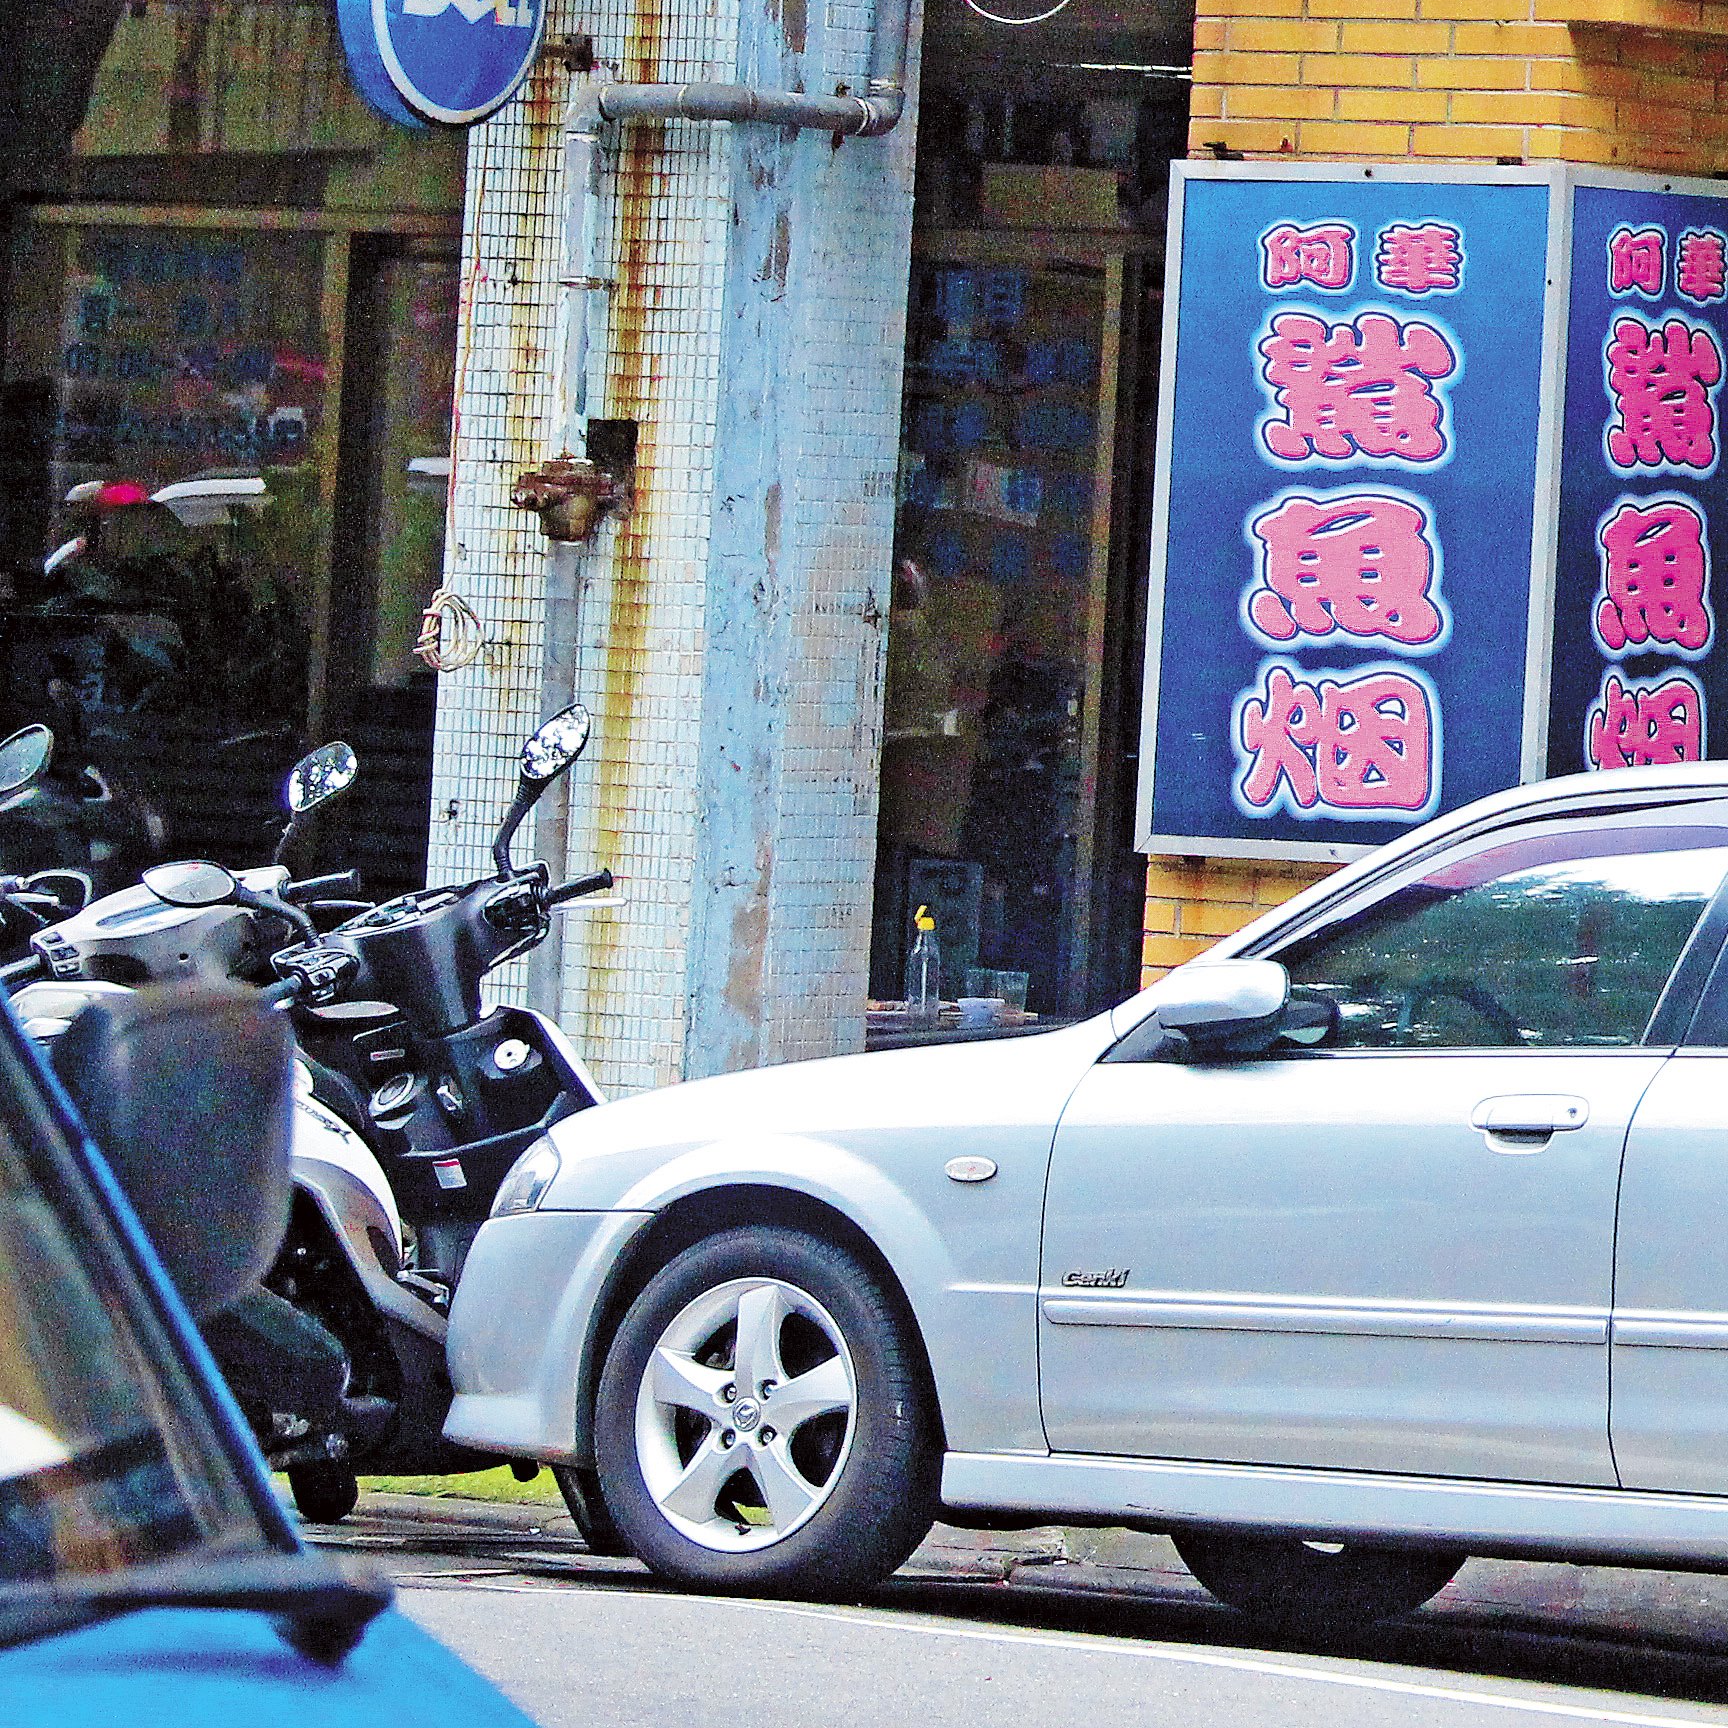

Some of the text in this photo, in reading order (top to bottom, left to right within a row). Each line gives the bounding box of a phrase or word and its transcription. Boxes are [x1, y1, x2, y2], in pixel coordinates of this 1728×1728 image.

[1261, 222, 1462, 294] 阿華
[1240, 311, 1457, 810] 鯊魚烟
